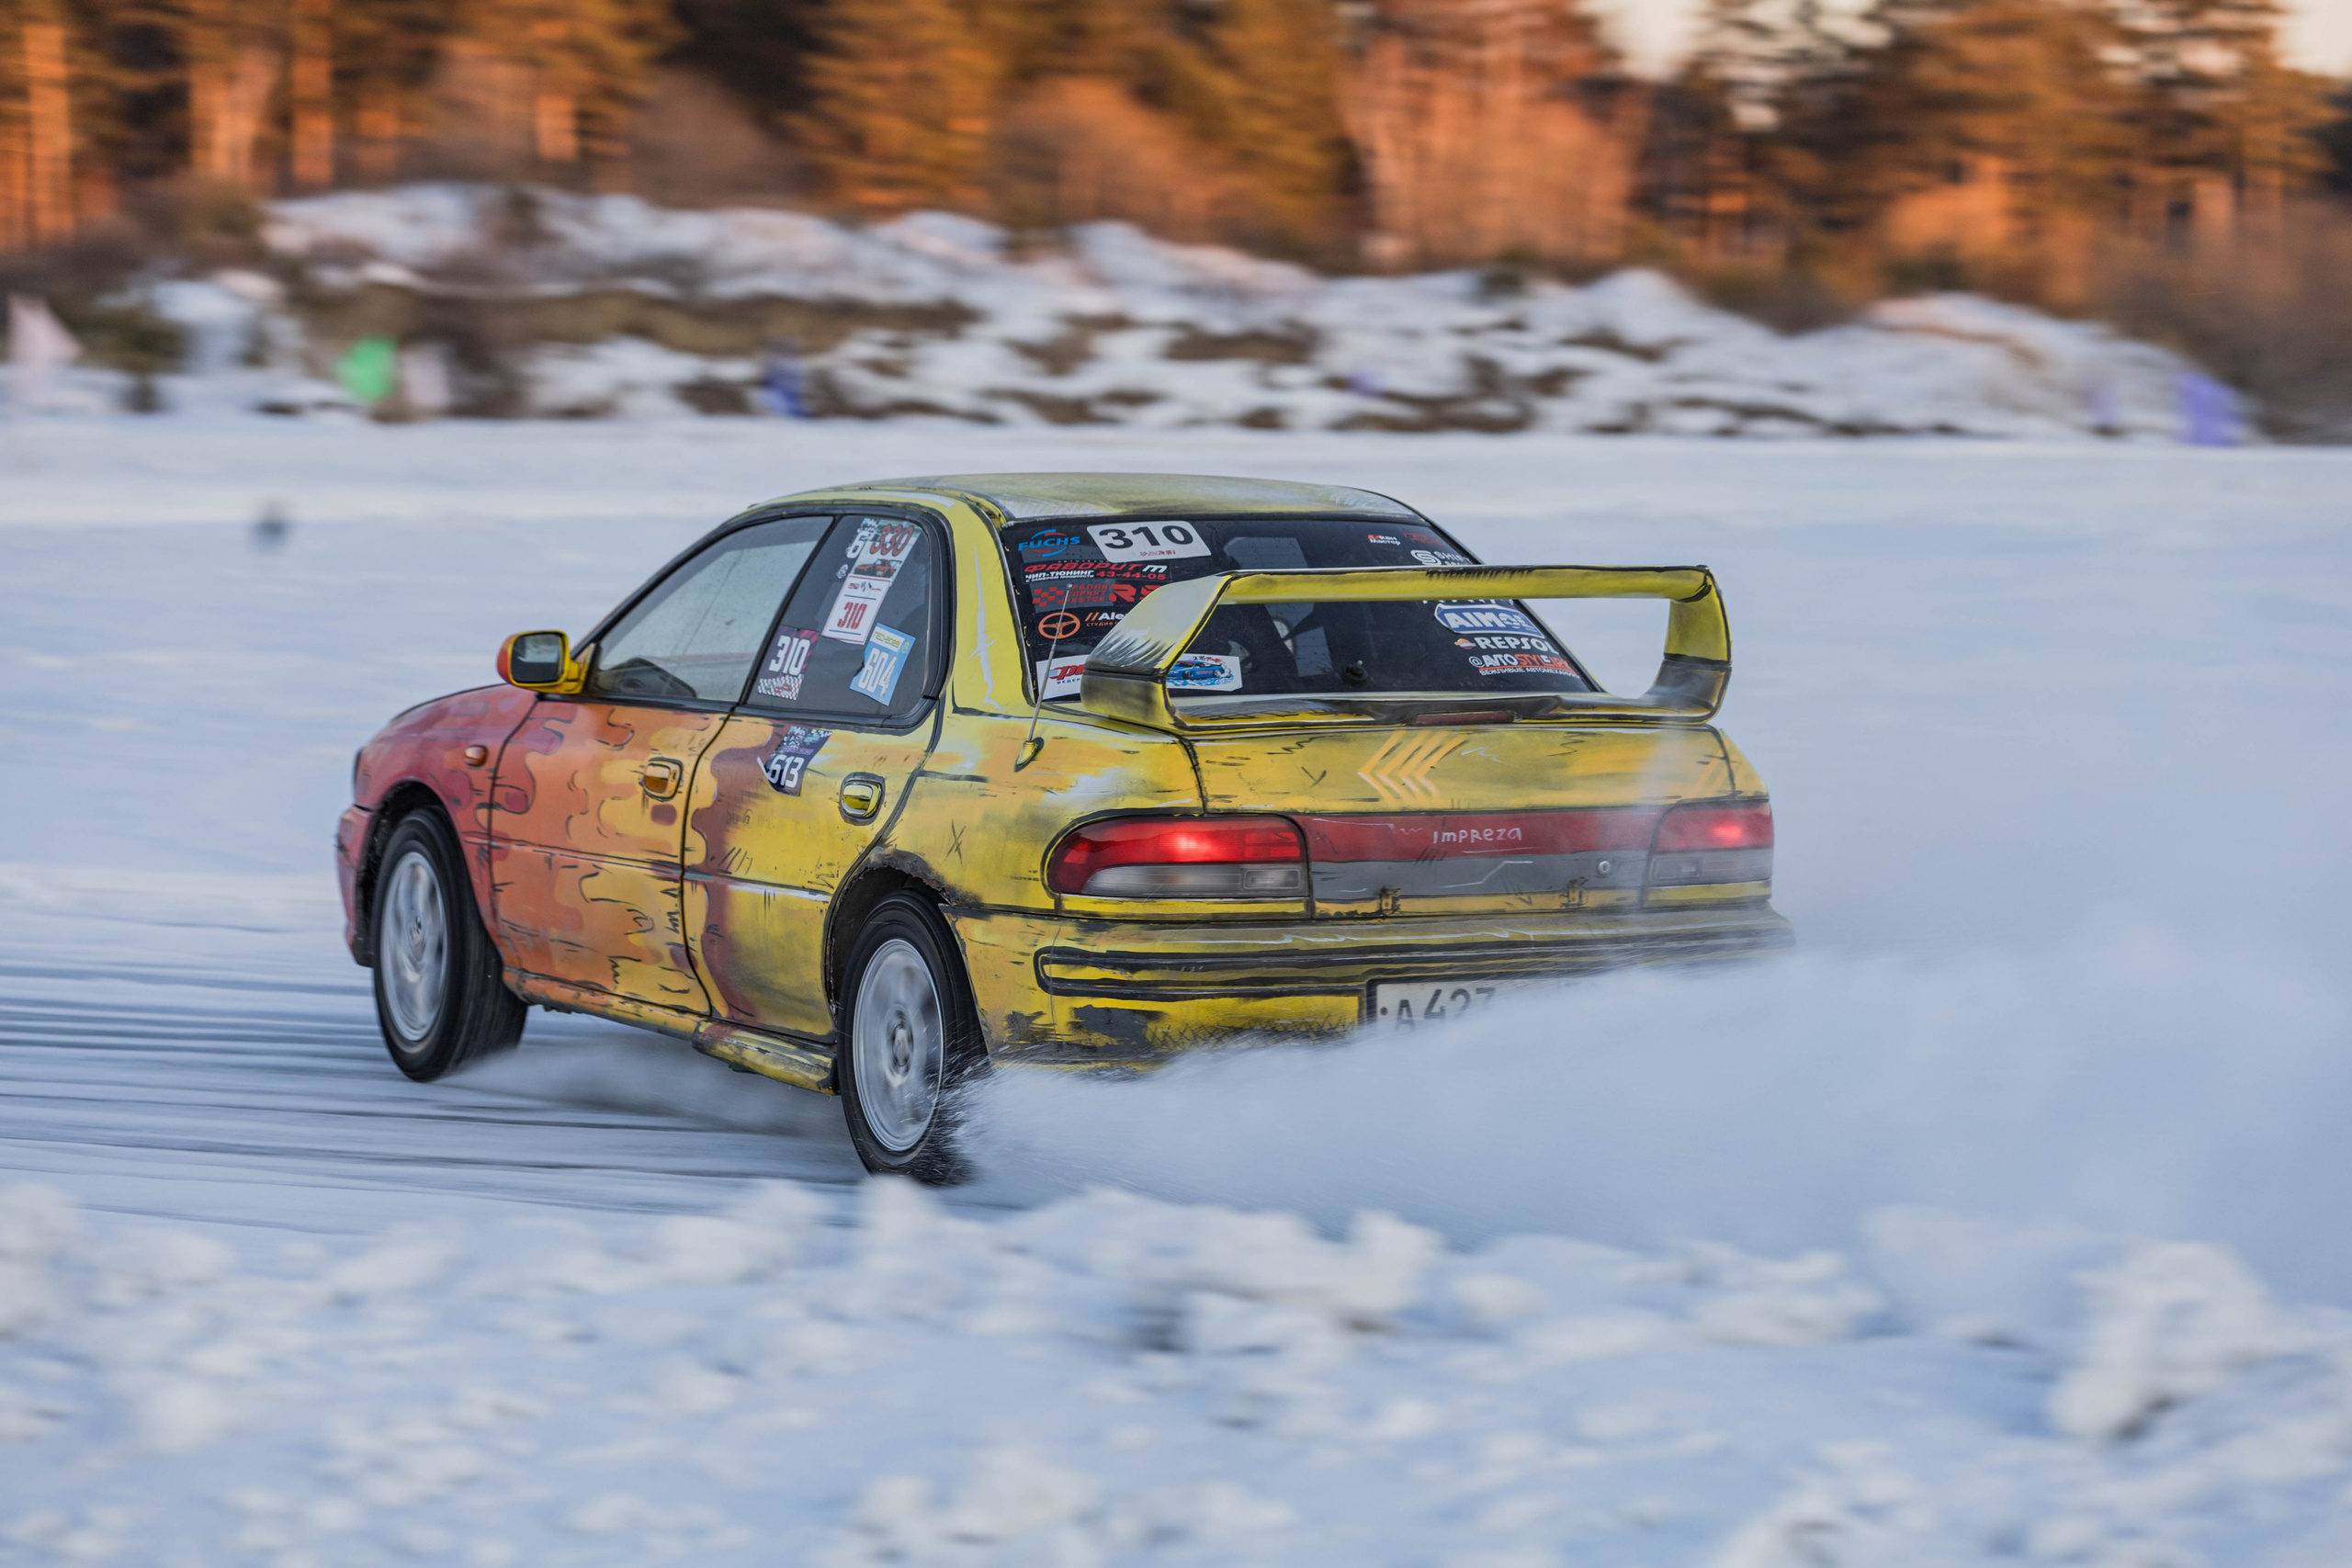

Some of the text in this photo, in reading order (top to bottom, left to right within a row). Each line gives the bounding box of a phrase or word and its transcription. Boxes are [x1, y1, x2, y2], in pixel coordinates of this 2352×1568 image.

[869, 525, 914, 557] 330
[1018, 536, 1080, 551] FUCHS
[1099, 525, 1193, 549] 310
[1025, 570, 1094, 580] ЧИП-ТЮНИНГ
[1096, 570, 1167, 581] 43-44-05
[837, 602, 867, 629] 310
[769, 635, 810, 676] 310
[1474, 637, 1559, 654] REPSOL
[858, 648, 897, 698] 604
[768, 754, 805, 788] 613
